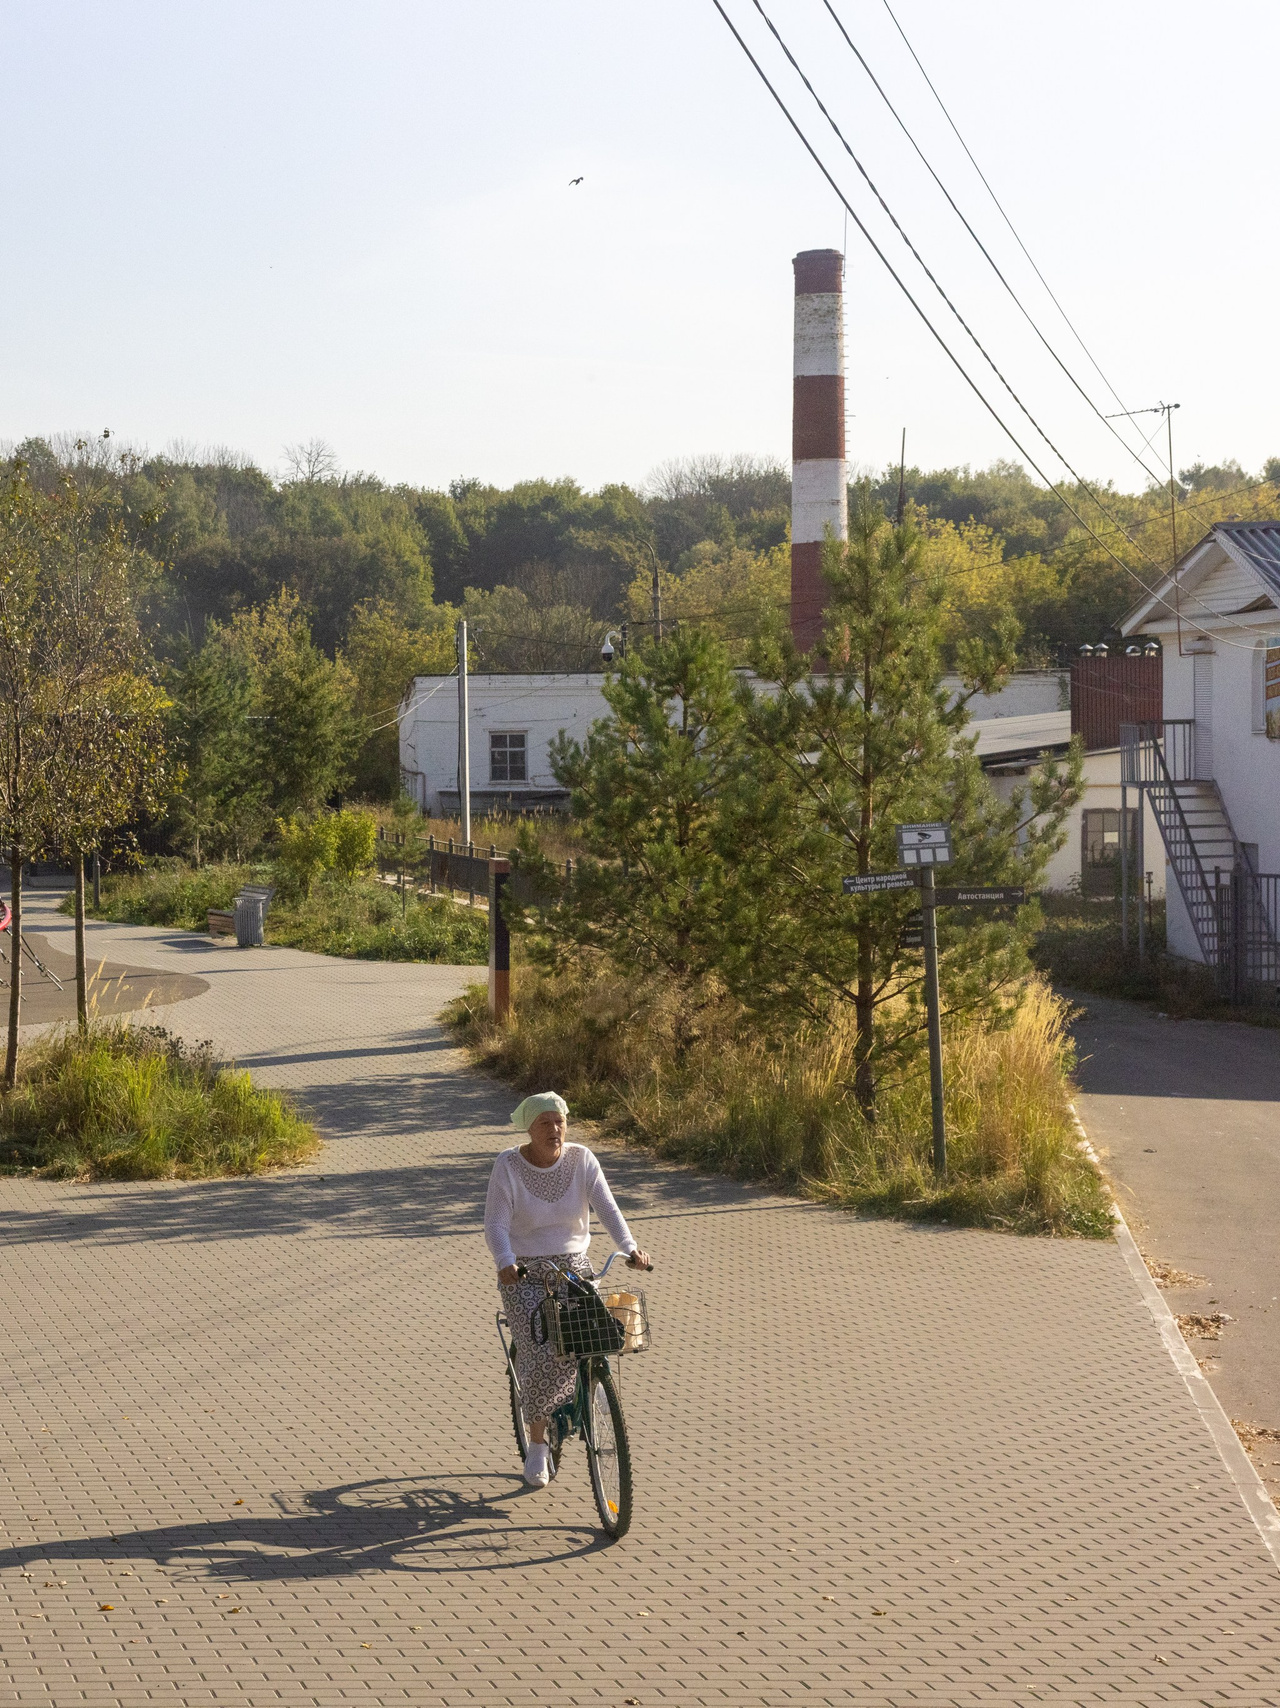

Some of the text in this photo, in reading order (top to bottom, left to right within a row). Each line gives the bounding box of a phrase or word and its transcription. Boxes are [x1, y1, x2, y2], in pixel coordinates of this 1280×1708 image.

[855, 873, 907, 884] Центр народной
[850, 884, 880, 892] культуры
[887, 880, 914, 889] ремесла
[957, 892, 1004, 901] Автостанция
